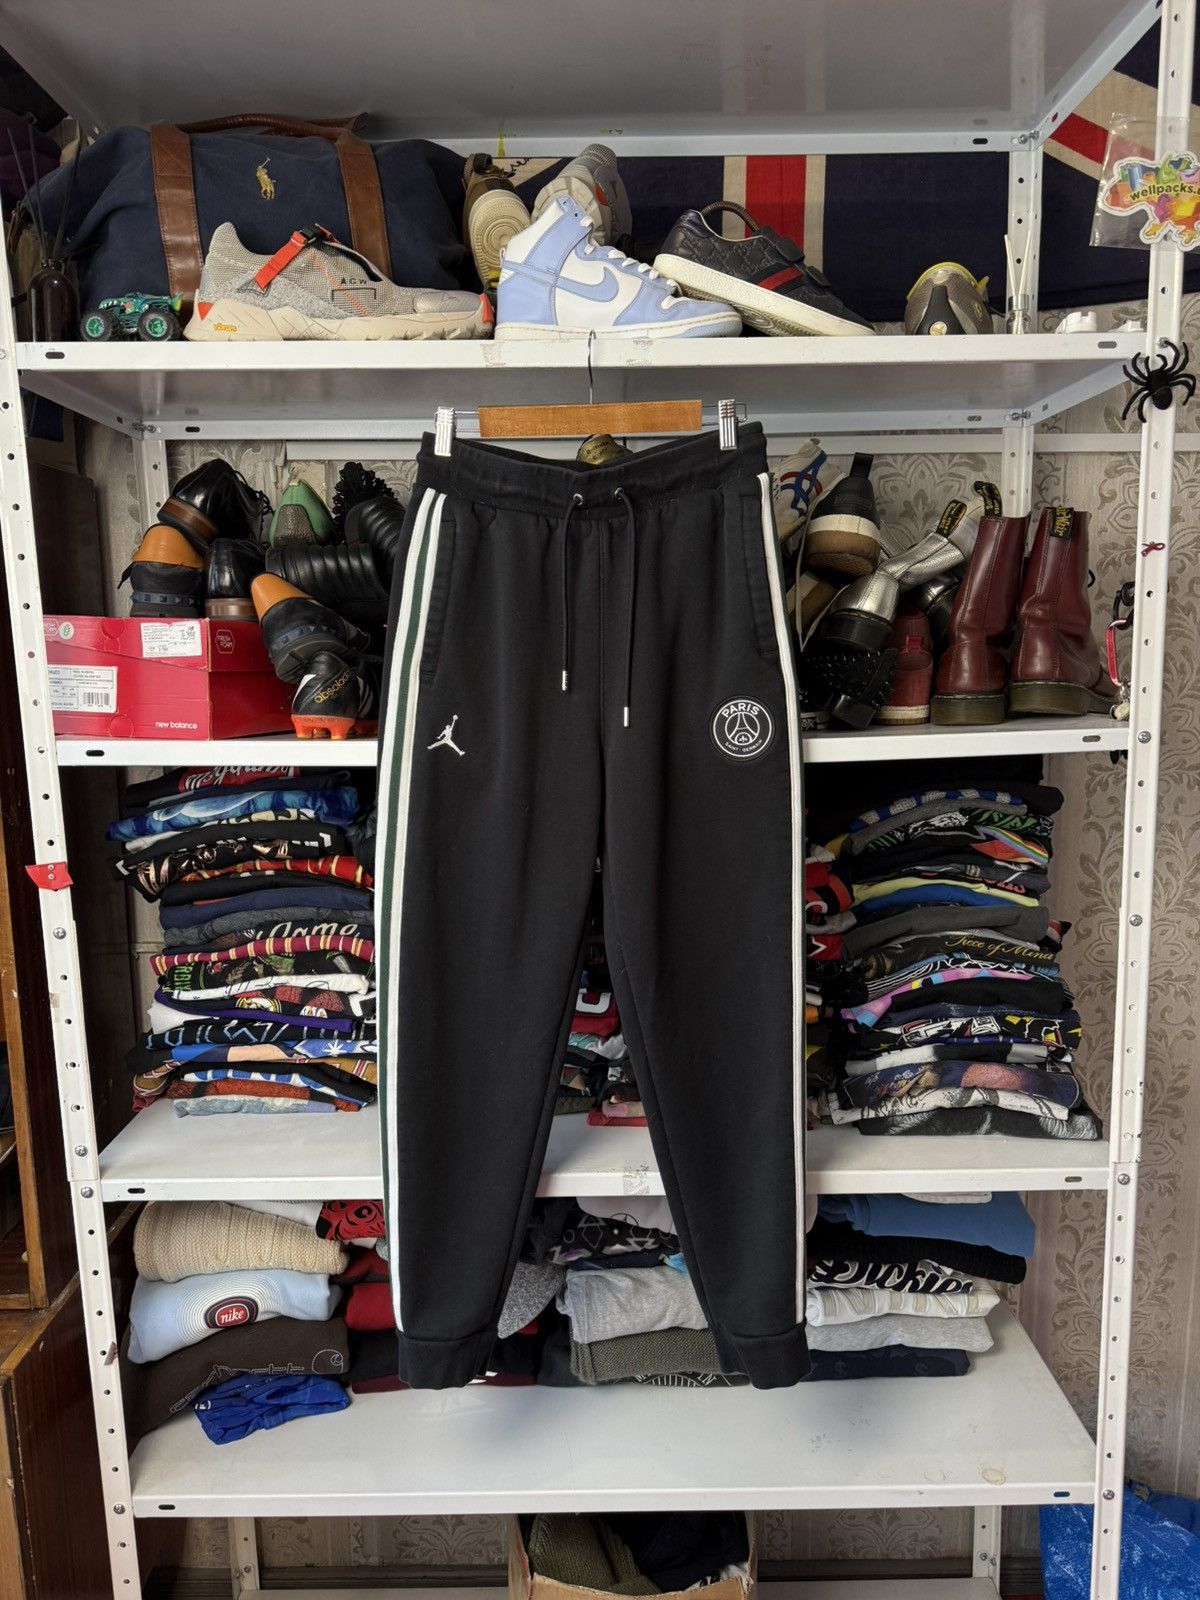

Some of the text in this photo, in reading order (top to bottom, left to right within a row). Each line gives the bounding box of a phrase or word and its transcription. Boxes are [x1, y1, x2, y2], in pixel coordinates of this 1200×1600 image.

[721, 702, 760, 718] PARIS
[155, 720, 198, 730] new balance
[987, 941, 1004, 957] of
[221, 1307, 244, 1324] nike
